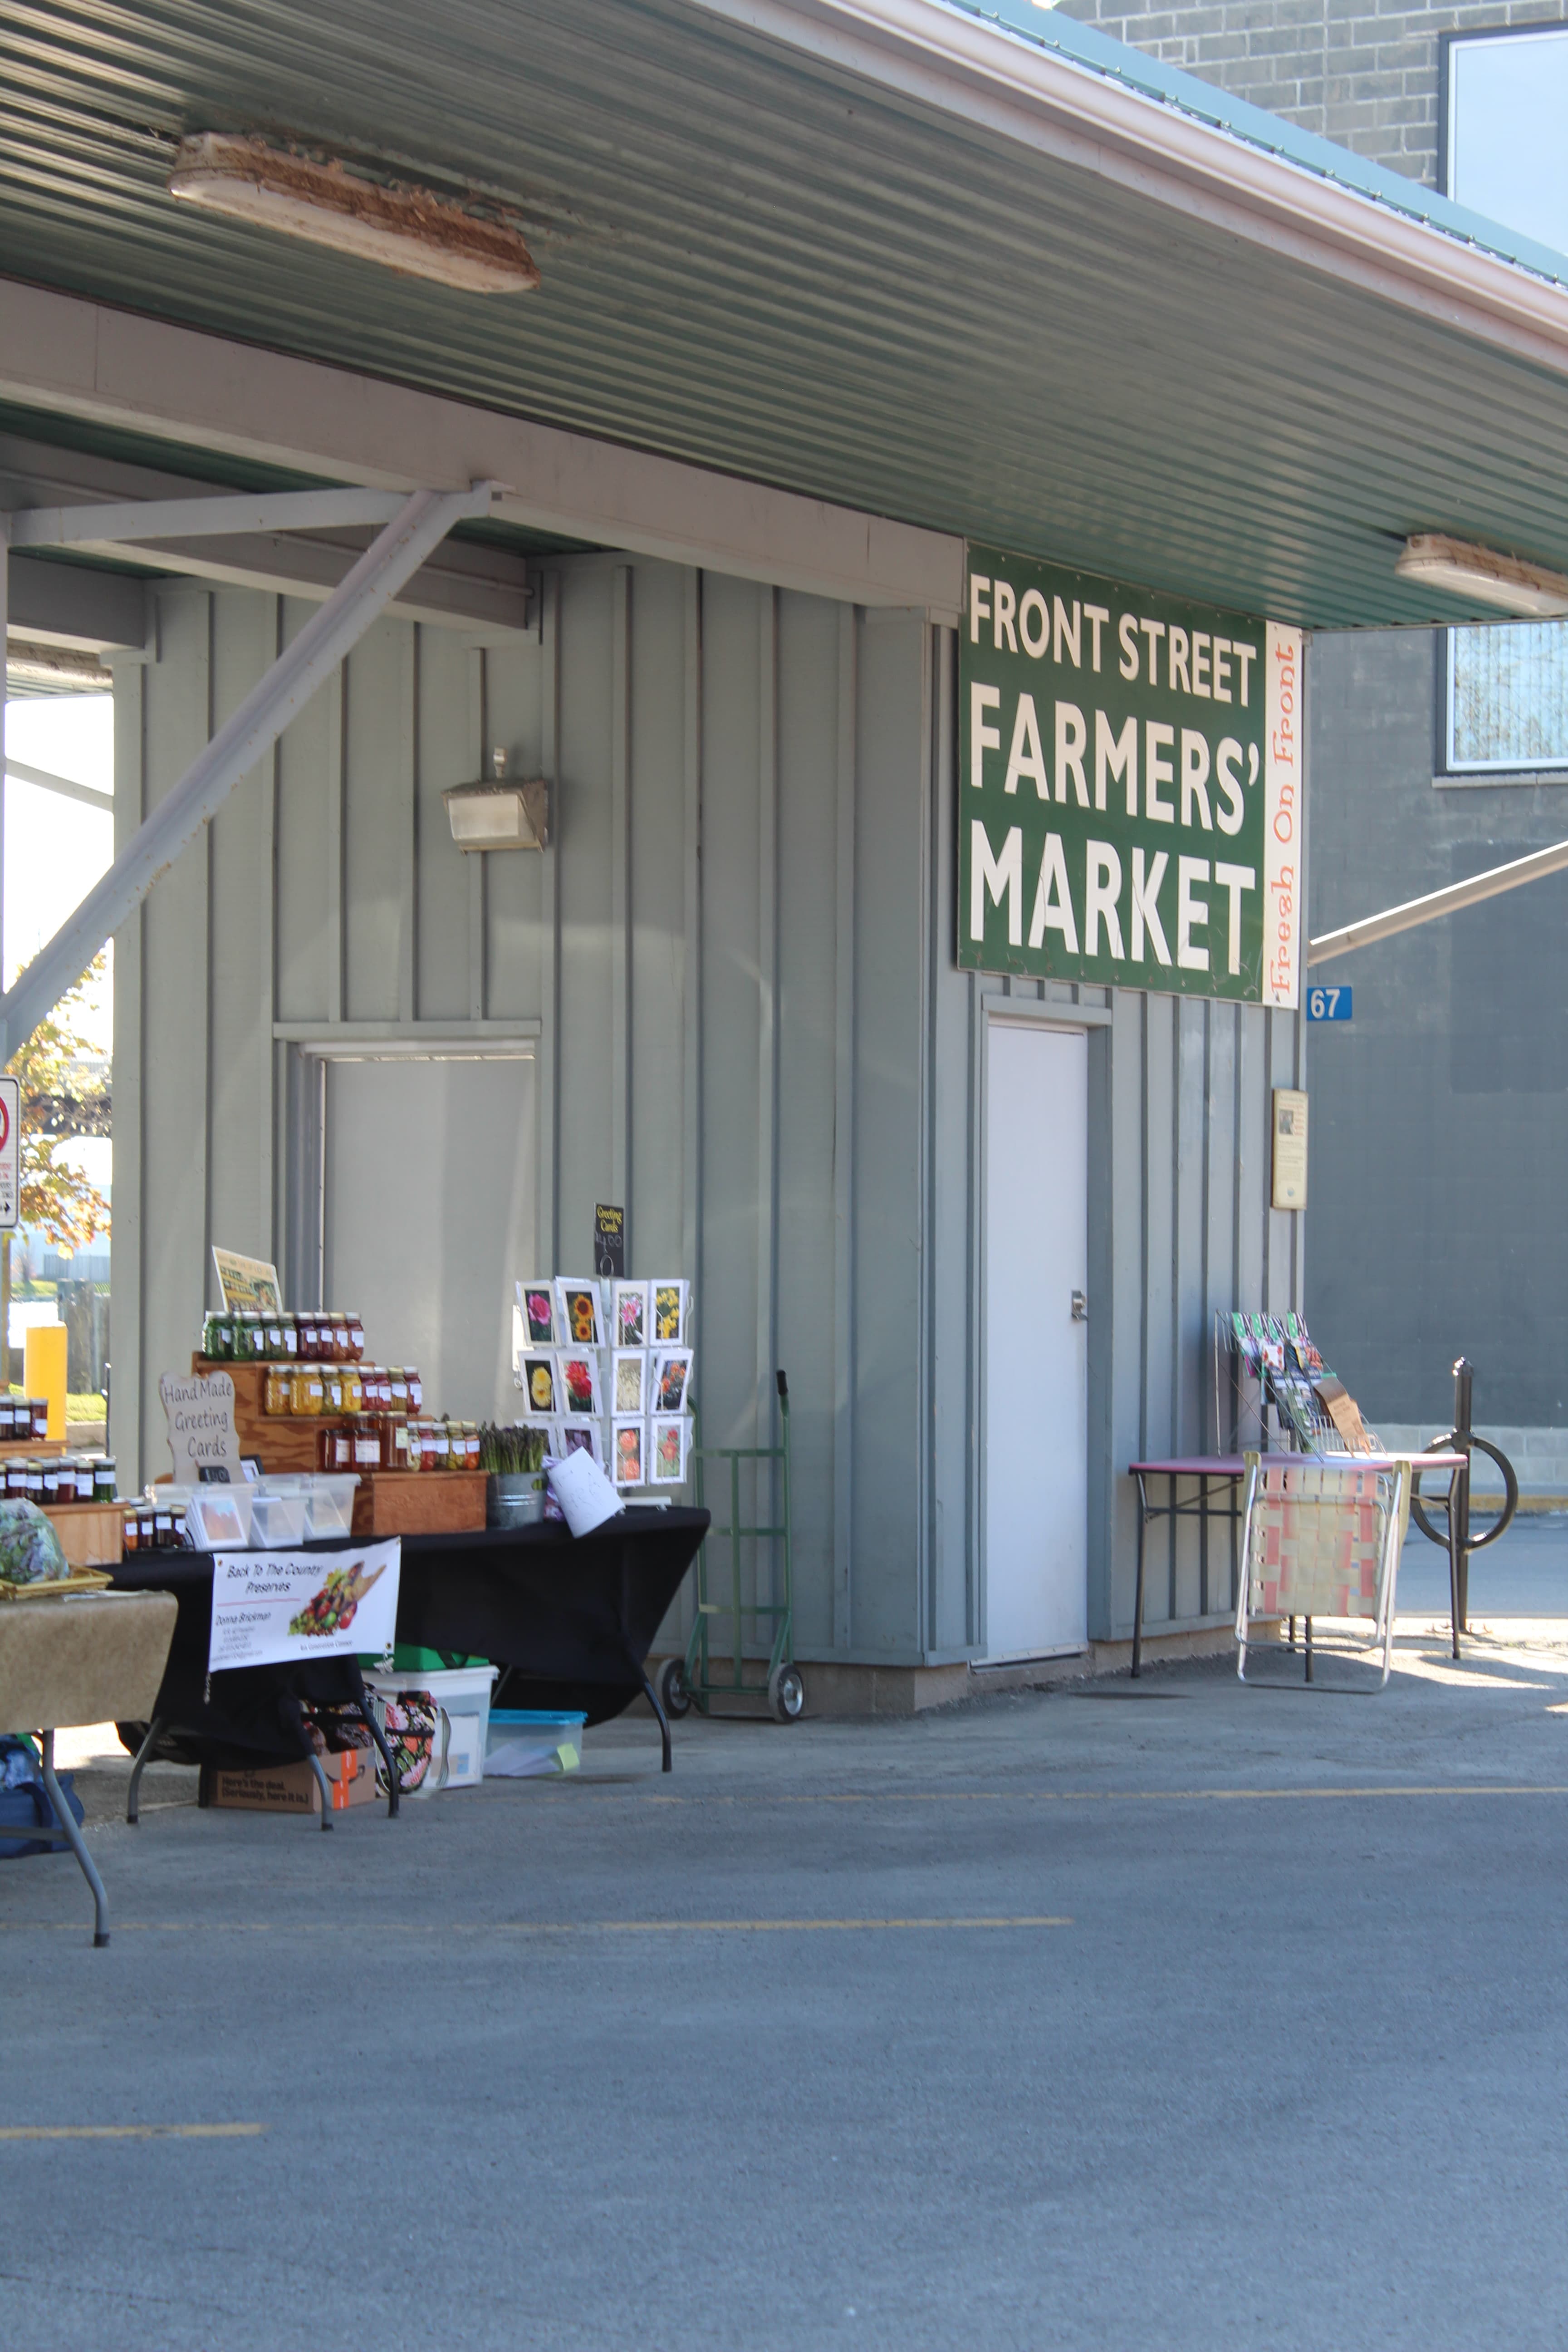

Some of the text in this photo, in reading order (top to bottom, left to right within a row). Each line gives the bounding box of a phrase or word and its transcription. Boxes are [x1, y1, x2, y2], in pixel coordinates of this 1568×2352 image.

[970, 573, 1257, 707] FRONT STREET
[970, 681, 1260, 836] FARMERS'
[1271, 643, 1296, 995] Fresh On Front
[970, 819, 1256, 975] MARKET
[1311, 989, 1340, 1019] 67
[164, 1377, 232, 1403] Hand Made
[175, 1406, 228, 1432] Greeting
[188, 1435, 226, 1458] Cards
[227, 1564, 250, 1578] Back
[266, 1563, 283, 1576] The
